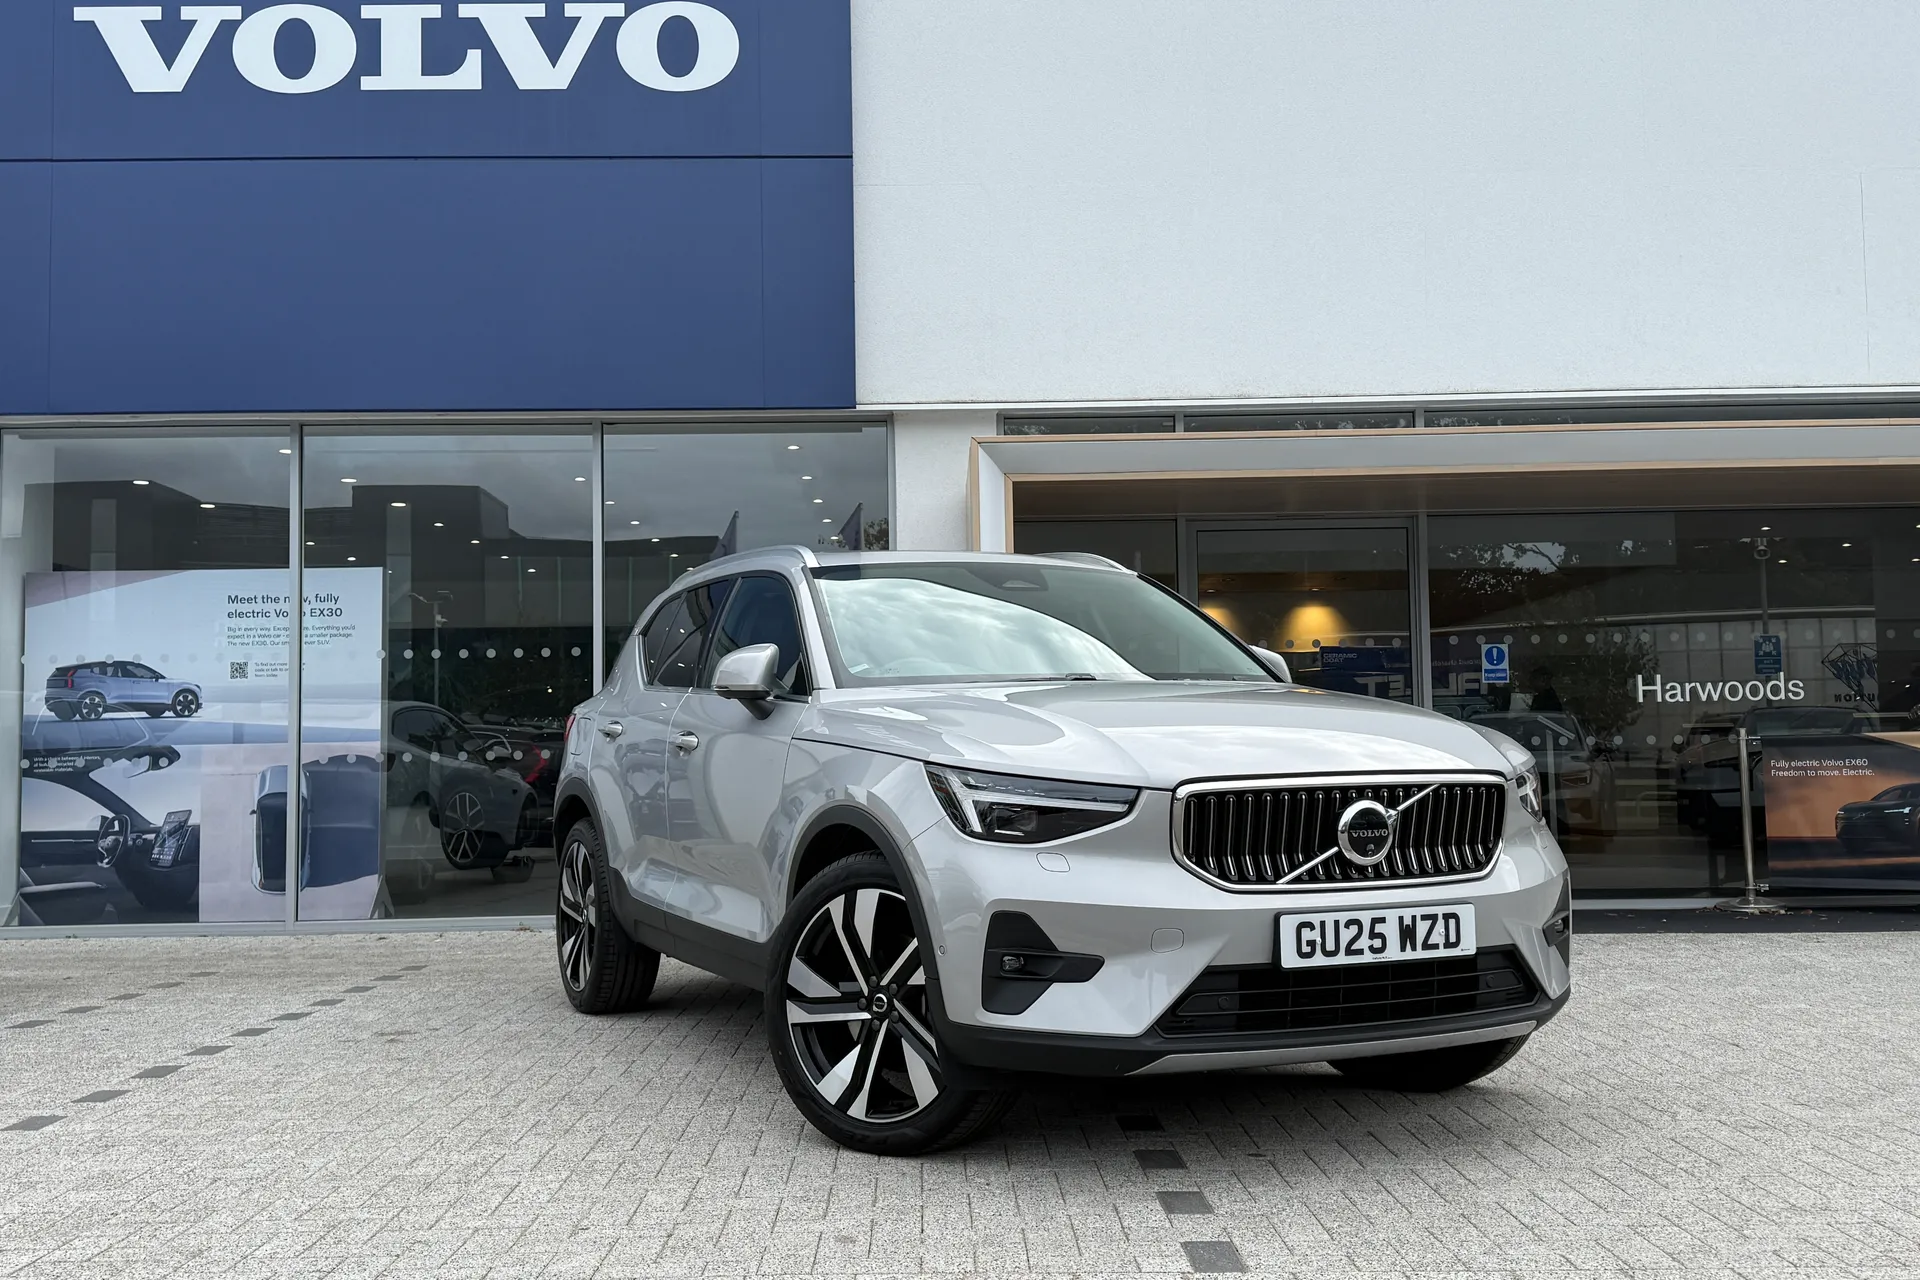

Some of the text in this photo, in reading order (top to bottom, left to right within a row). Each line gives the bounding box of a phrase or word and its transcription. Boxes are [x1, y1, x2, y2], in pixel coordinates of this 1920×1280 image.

[73, 1, 740, 94] VOLVO
[228, 594, 258, 604] Meet
[262, 594, 280, 604] the
[315, 594, 340, 605] fully
[228, 608, 270, 618] electric
[310, 608, 342, 618] EX30
[1637, 672, 1805, 702] Harwoods
[1771, 760, 1789, 768] Fully
[1350, 828, 1388, 837] VOLVO
[1296, 912, 1462, 959] GU25 WZD
